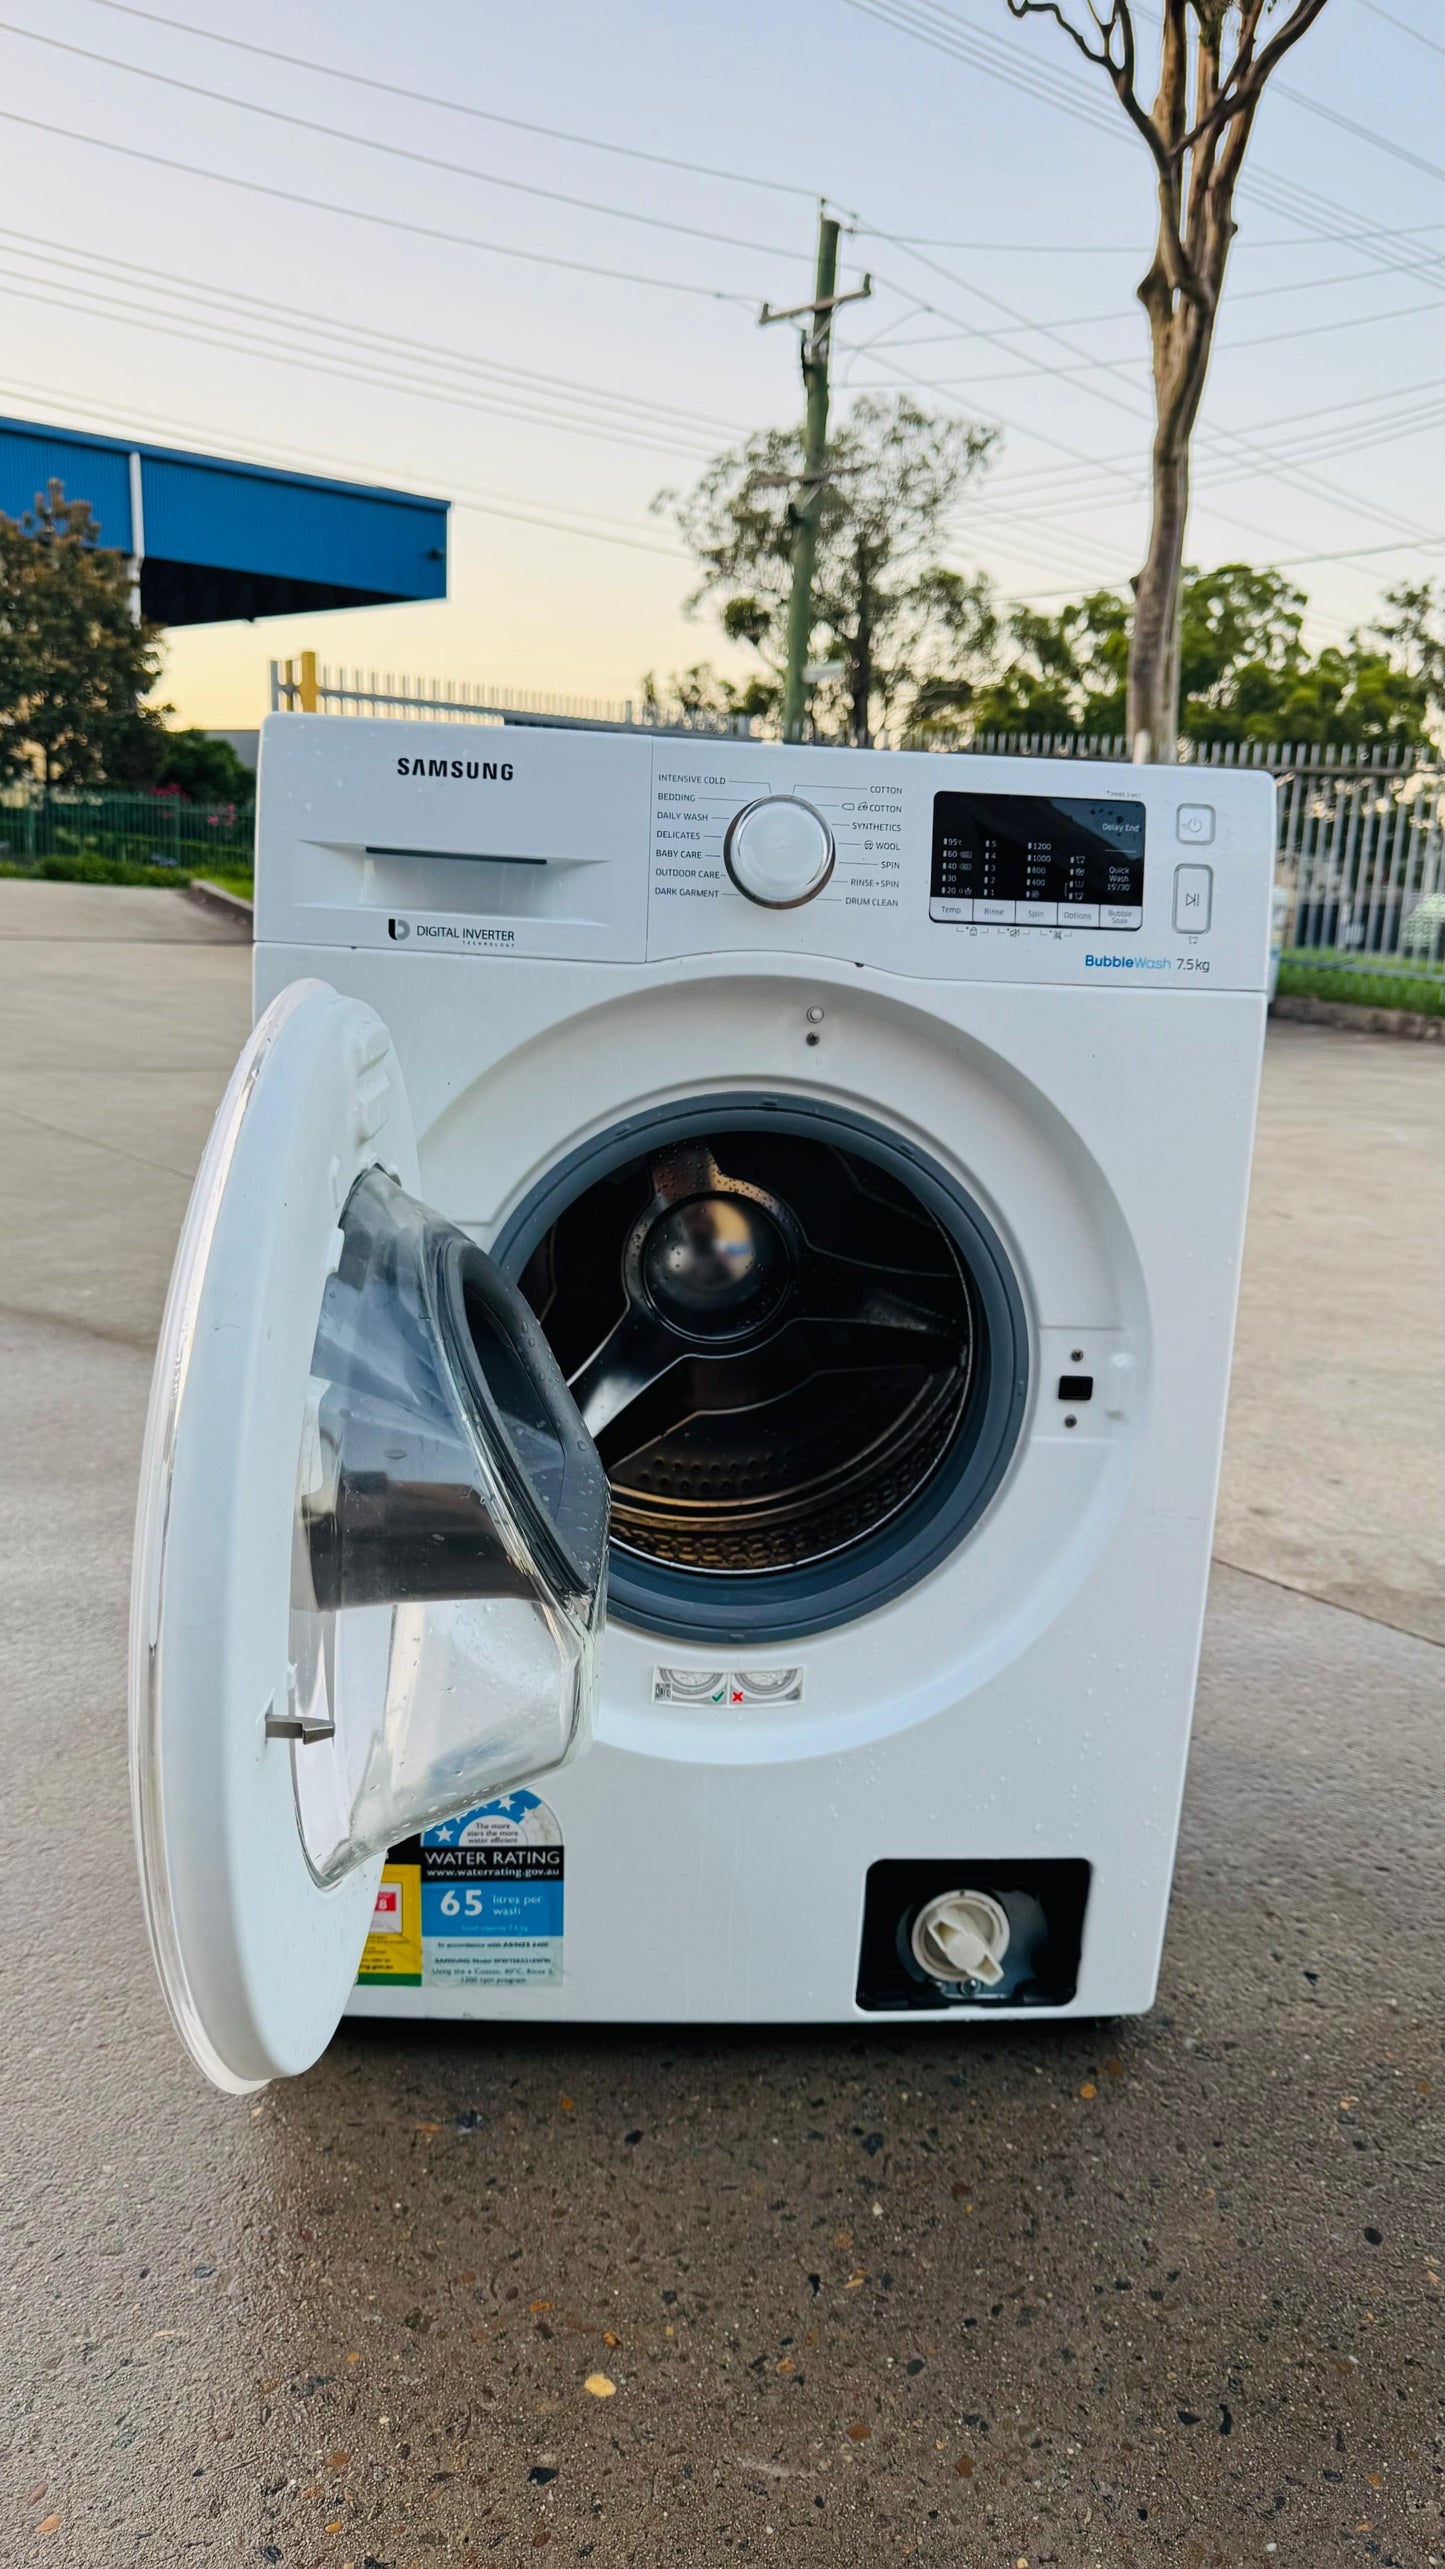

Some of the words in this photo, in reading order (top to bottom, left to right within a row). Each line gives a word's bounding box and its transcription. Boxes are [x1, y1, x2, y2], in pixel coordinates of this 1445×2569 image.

[397, 758, 513, 781] SAMSUNG
[658, 774, 702, 784] INTENSIVE
[704, 776, 726, 785] COLD
[870, 786, 902, 794] COTTON
[658, 792, 696, 802] BEDDING
[870, 804, 902, 813] COTTON
[657, 812, 681, 820] DAILY
[684, 813, 708, 821] WASH
[852, 822, 902, 832] SYNTHETICS
[1102, 823, 1124, 832] Delay
[1125, 824, 1140, 832] End
[656, 830, 700, 840] DELICATES
[876, 842, 901, 851] WOOL
[656, 849, 678, 857] BABY
[681, 851, 702, 859] CARE
[881, 861, 900, 869] SPIN
[1109, 866, 1129, 874] Quick
[656, 868, 696, 878] OUTDOOR
[698, 870, 720, 879] CARE
[851, 878, 874, 887] RINSE
[880, 880, 899, 888] SPIN
[655, 887, 677, 896] DARK
[680, 888, 720, 898] GARMENT
[846, 897, 870, 906] DRUM
[872, 898, 898, 906] CLEAN
[984, 908, 1004, 916] Rinse
[1028, 910, 1044, 919] Spin
[1064, 911, 1092, 921] Options
[1108, 909, 1132, 918] Bubble
[416, 925, 459, 938] DIGITAL
[462, 928, 515, 941] INVERTER
[1085, 954, 1171, 969] BubbleWash
[425, 1851, 487, 1865] WATER
[493, 1851, 560, 1864] RATING
[427, 1867, 559, 1878] www.waterrating.gov.au
[440, 1889, 483, 1916] 65
[493, 1895, 520, 1904] litres
[524, 1896, 542, 1906] per
[493, 1907, 520, 1915] wash
